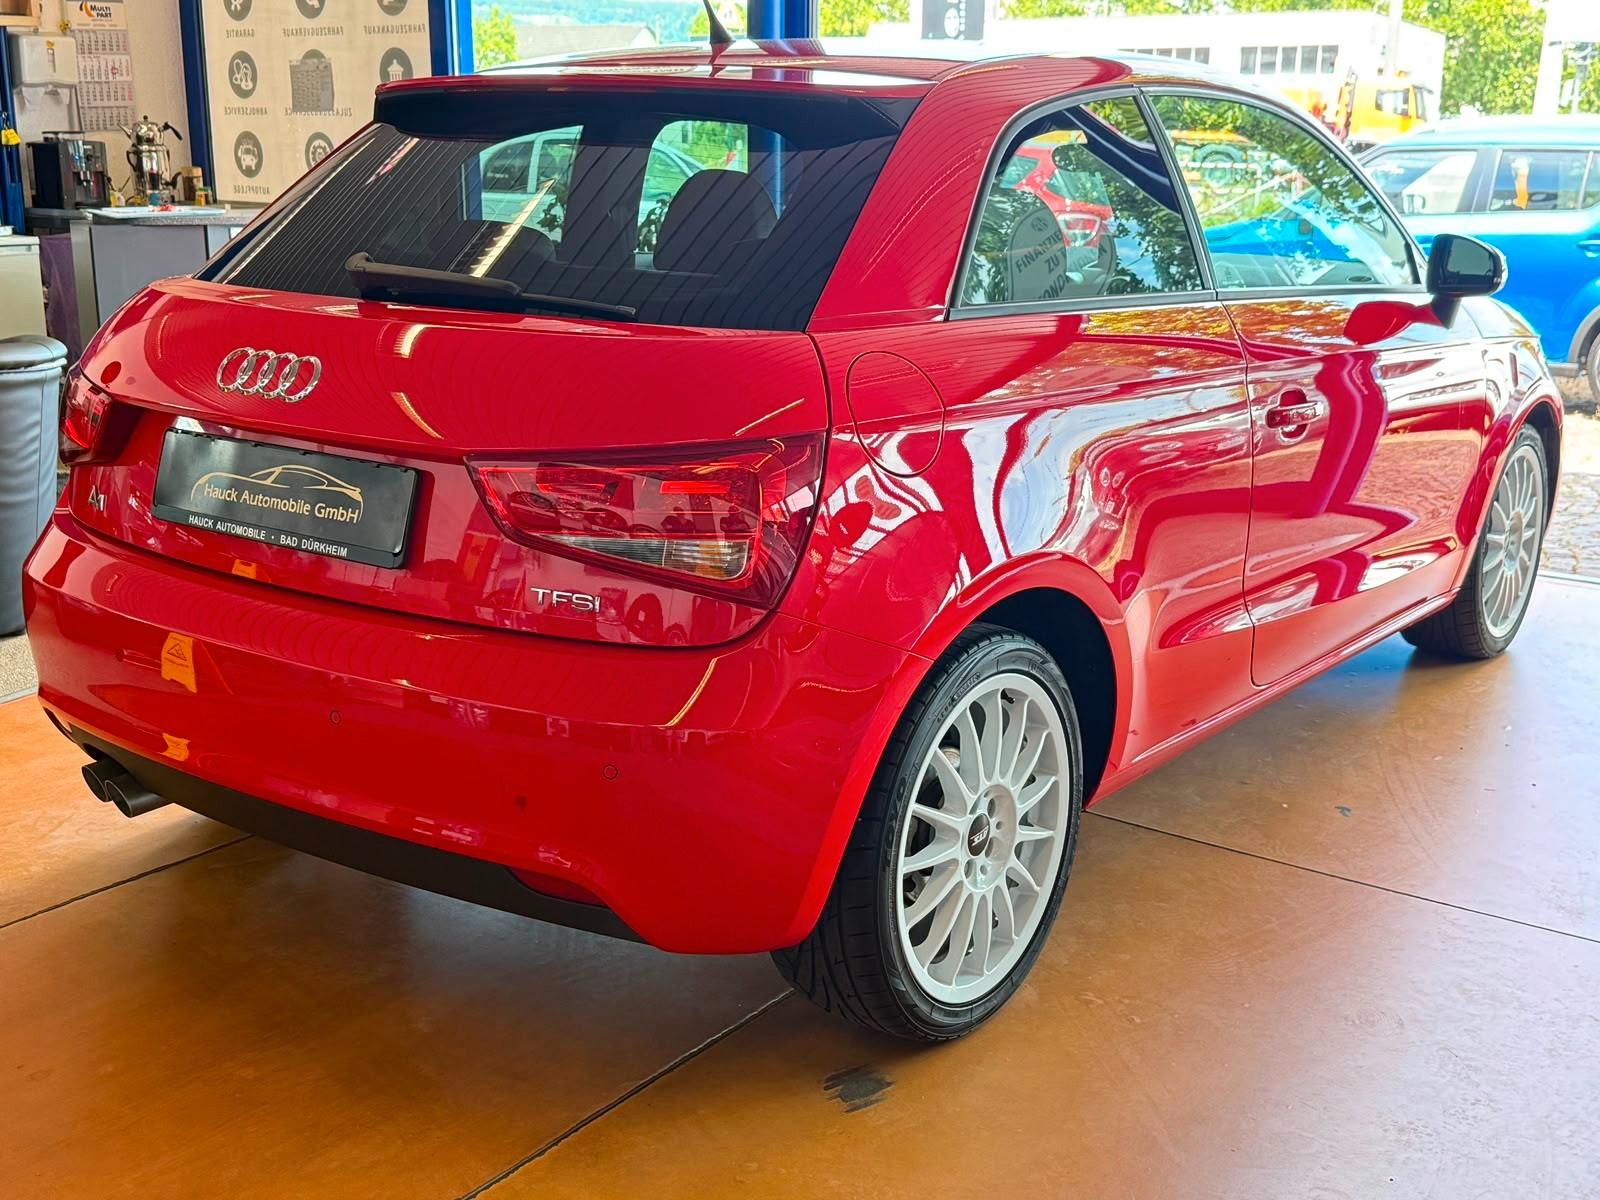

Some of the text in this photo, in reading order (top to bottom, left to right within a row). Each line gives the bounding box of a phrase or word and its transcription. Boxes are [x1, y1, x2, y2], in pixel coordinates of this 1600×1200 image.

[88, 485, 105, 511] A1
[204, 483, 359, 524] Hauck Automobile GmbH
[188, 514, 348, 557] HAUCK AUTOMOBILE BAD DÜRKHEIM
[530, 587, 601, 613] TFSI
